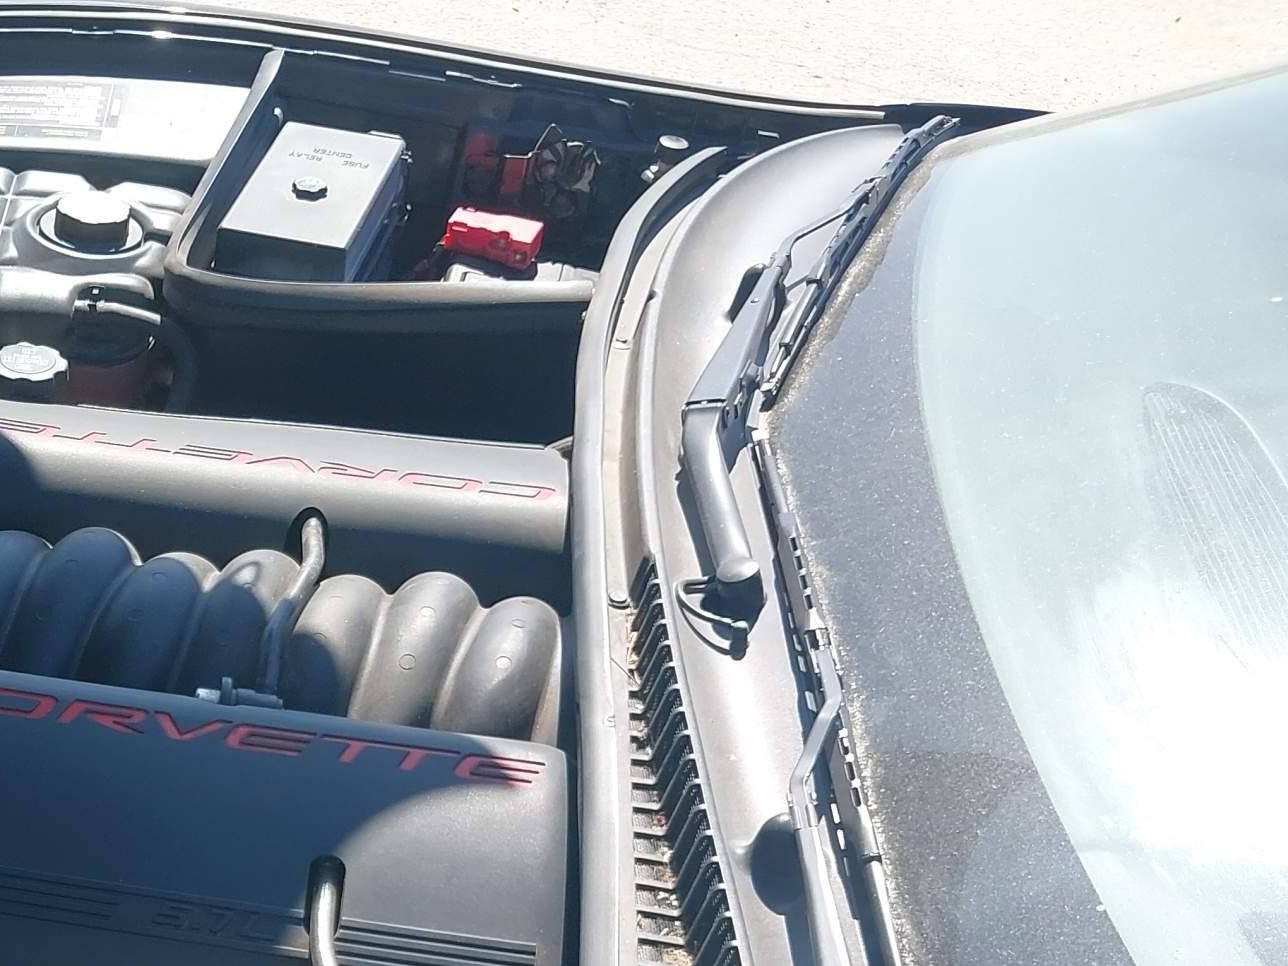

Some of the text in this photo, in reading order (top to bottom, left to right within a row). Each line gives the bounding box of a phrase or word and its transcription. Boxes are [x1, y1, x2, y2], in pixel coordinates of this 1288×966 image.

[288, 151, 370, 168] FUSE RELAY
[313, 148, 352, 159] CENTER
